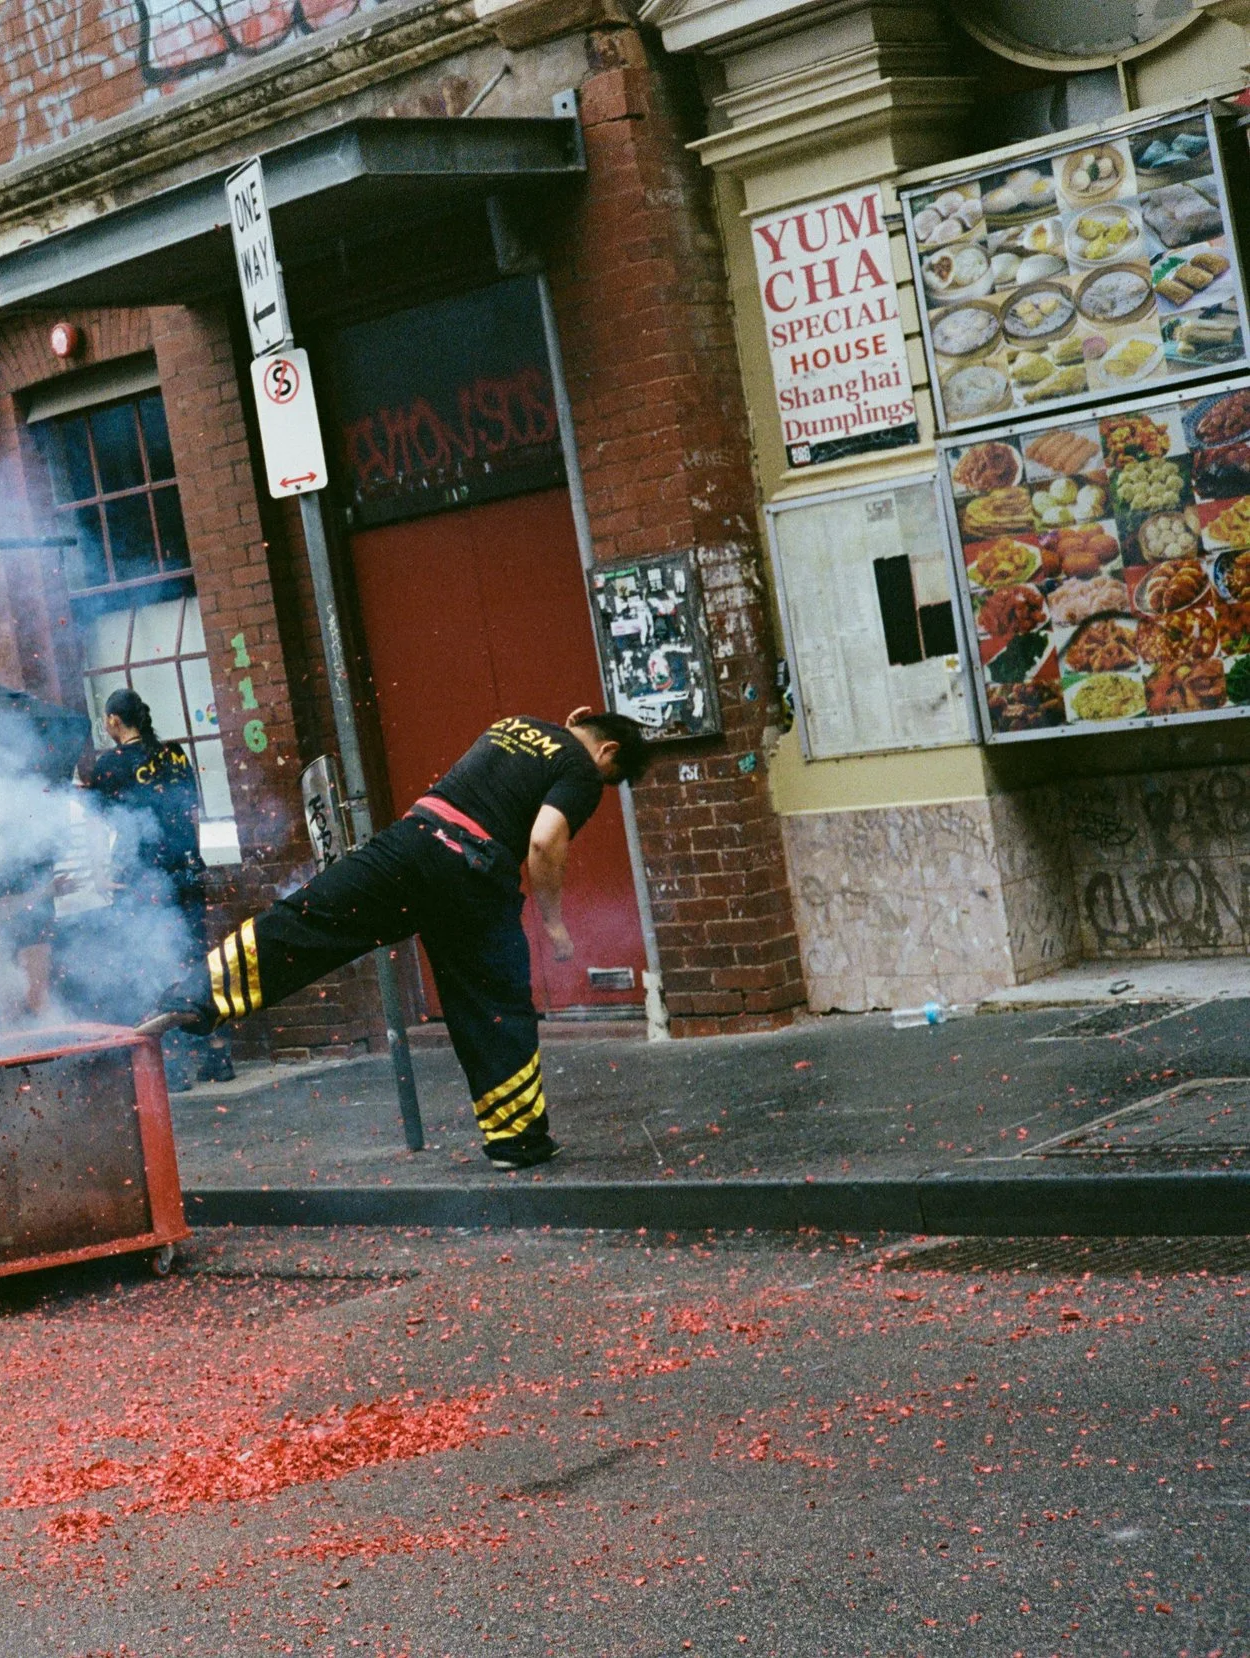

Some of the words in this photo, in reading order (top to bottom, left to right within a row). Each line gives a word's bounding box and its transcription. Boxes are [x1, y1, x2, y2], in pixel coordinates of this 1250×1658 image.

[234, 181, 261, 232] ONE
[754, 193, 884, 264] YUM
[240, 236, 269, 290] WAY
[764, 248, 888, 313] CHA
[771, 297, 900, 348] SPECIAL
[790, 334, 887, 375] HOUSE
[779, 362, 902, 411] Shanghai
[784, 399, 915, 442] Dumplings
